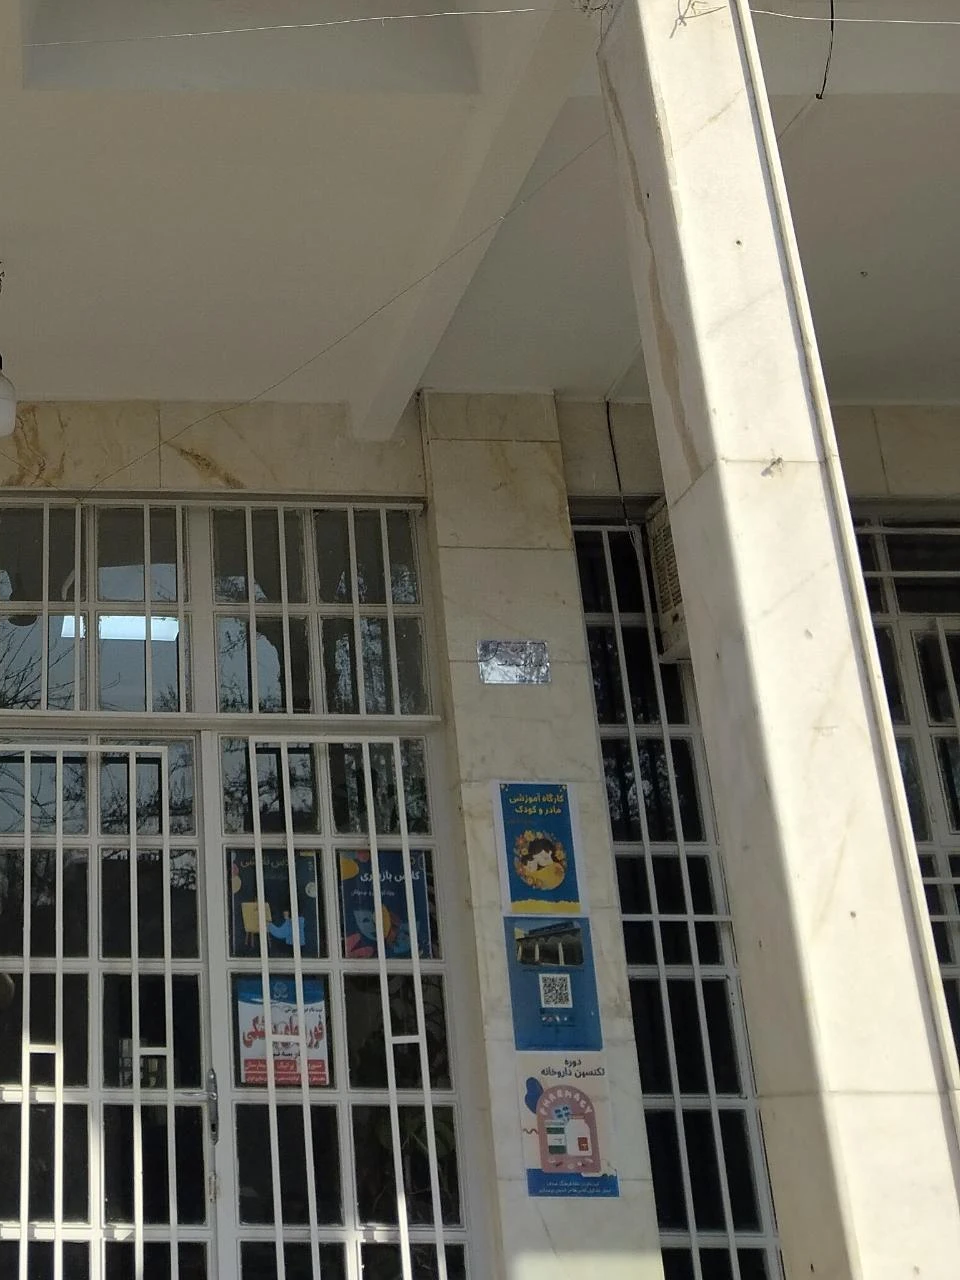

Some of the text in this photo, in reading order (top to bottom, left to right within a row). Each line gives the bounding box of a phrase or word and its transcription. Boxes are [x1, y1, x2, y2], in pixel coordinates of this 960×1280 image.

[509, 792, 565, 804] کارگاه آموزشی
[514, 805, 537, 815] کودک
[545, 805, 562, 816] مادر
[564, 1058, 582, 1068] دوره
[540, 1067, 572, 1078] داروخانه
[540, 1089, 593, 1116] PHARMACY
